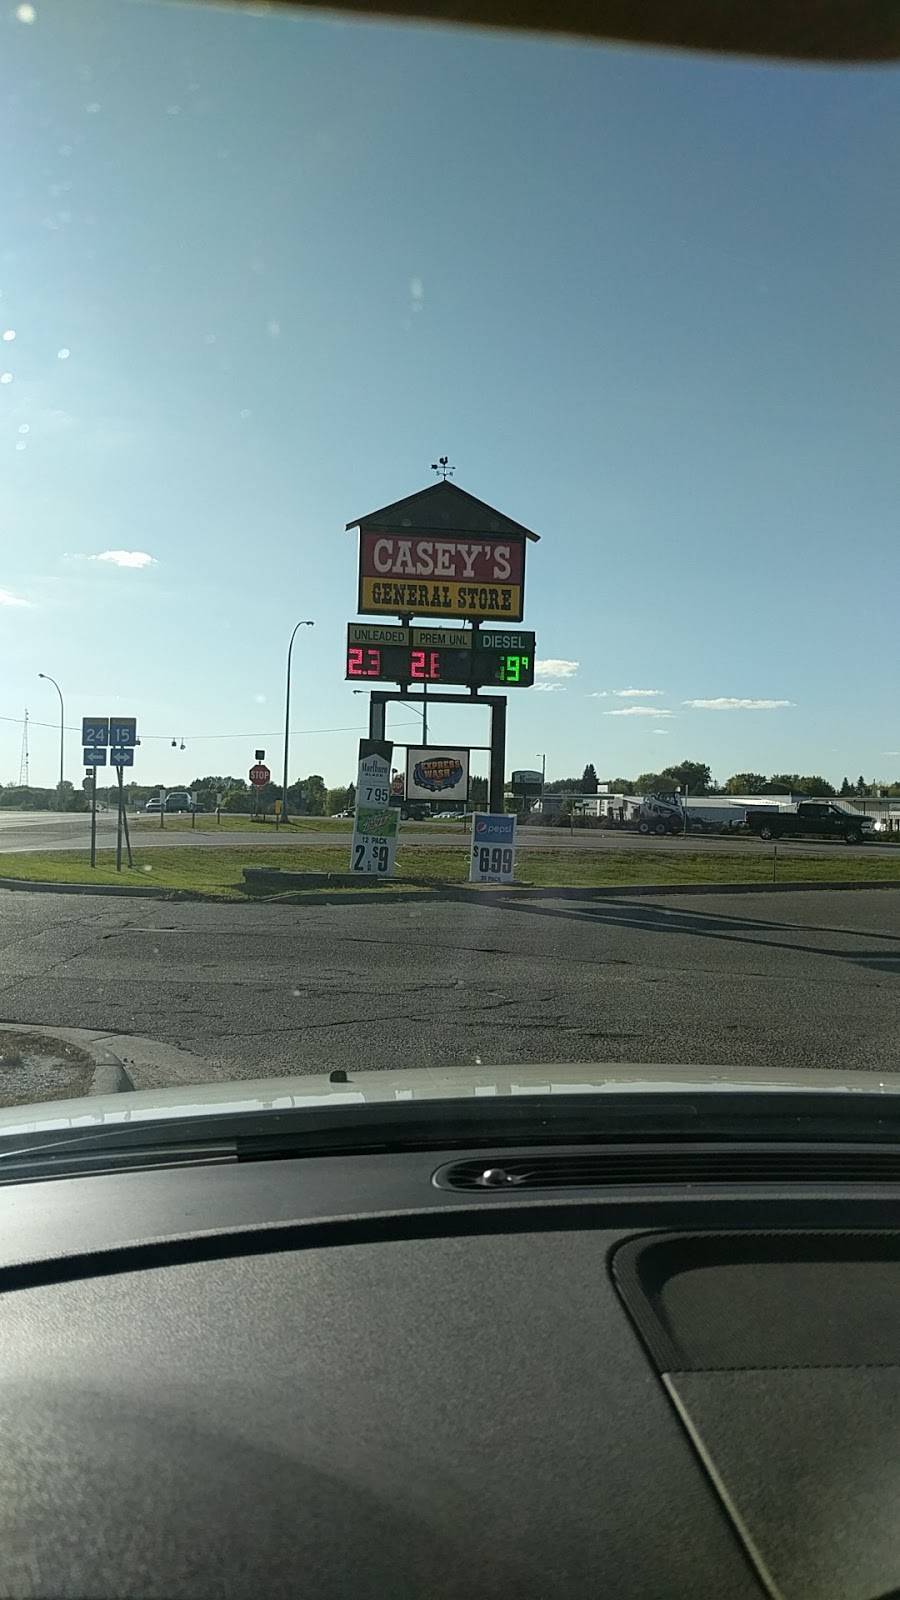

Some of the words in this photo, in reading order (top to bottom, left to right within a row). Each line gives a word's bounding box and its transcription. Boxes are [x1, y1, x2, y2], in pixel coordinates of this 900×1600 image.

[373, 538, 512, 580] CASEY'S
[372, 582, 452, 608] GENERAL
[457, 587, 512, 610] STORE
[354, 629, 405, 642] UNLEADED
[419, 632, 446, 645] PREM
[449, 634, 468, 646] UNL
[482, 635, 526, 649] DIESEL
[86, 728, 104, 742] 24
[116, 728, 130, 743] 15
[420, 760, 461, 770] EXPRESS
[250, 770, 269, 780] STOP
